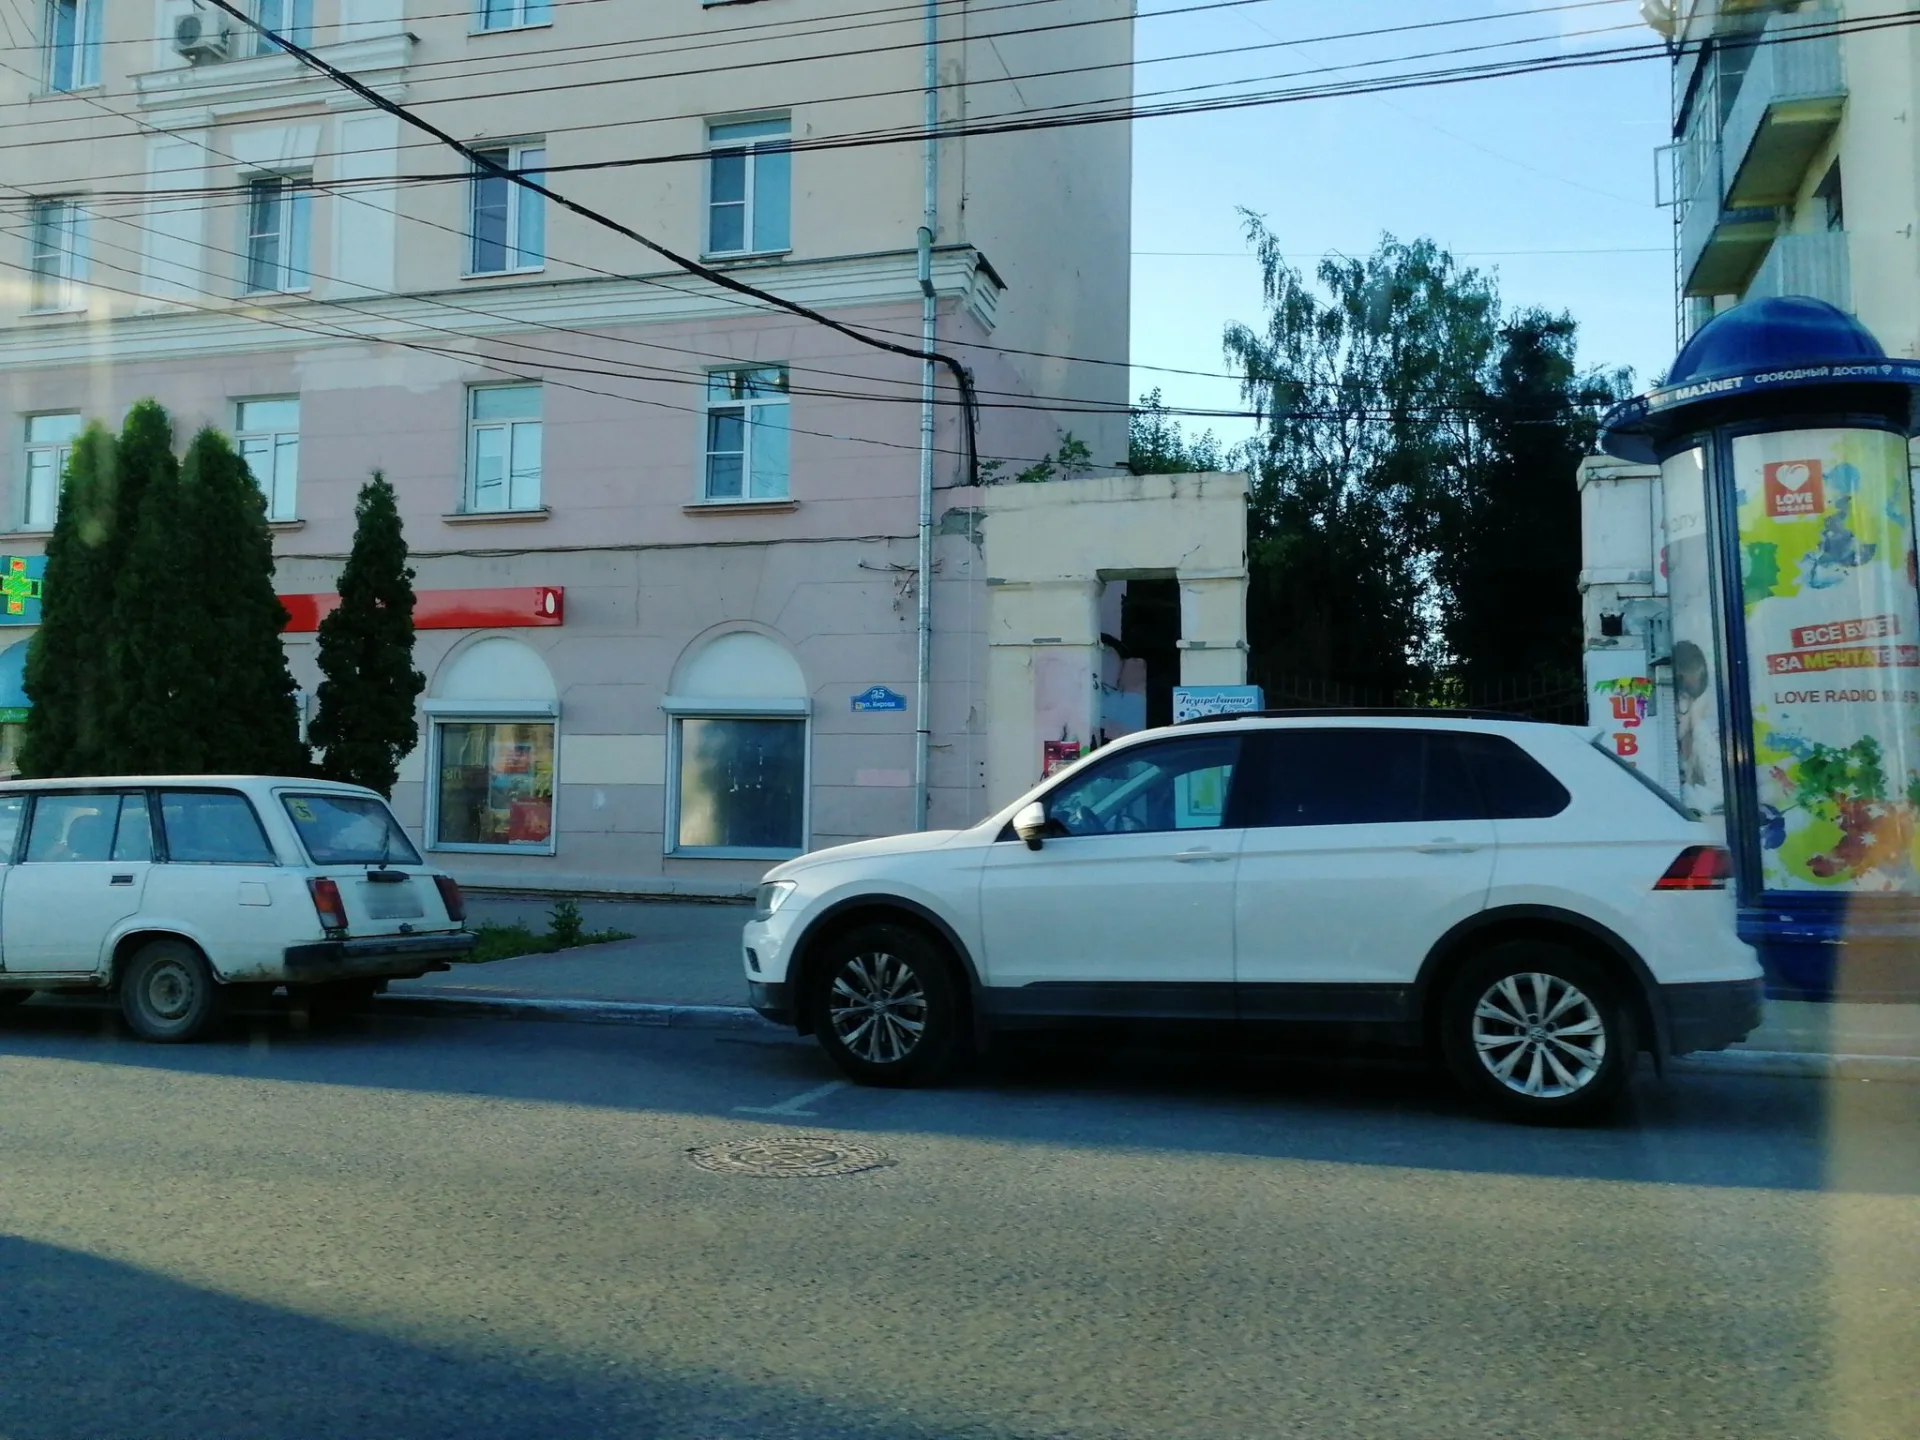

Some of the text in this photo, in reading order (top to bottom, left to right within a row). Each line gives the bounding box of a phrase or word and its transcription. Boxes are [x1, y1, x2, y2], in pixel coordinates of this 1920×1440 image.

[1754, 365, 1878, 383] СВОБОДНЫЙ ДОСТУП
[1676, 377, 1743, 400] MAXNET
[1775, 492, 1814, 506] LOVE
[1801, 619, 1894, 644] ВСЕ БУДЕ
[871, 690, 885, 700] 25
[1177, 692, 1253, 706] Газированная
[1774, 690, 1820, 705] LOVE
[1825, 689, 1877, 703] RADIO
